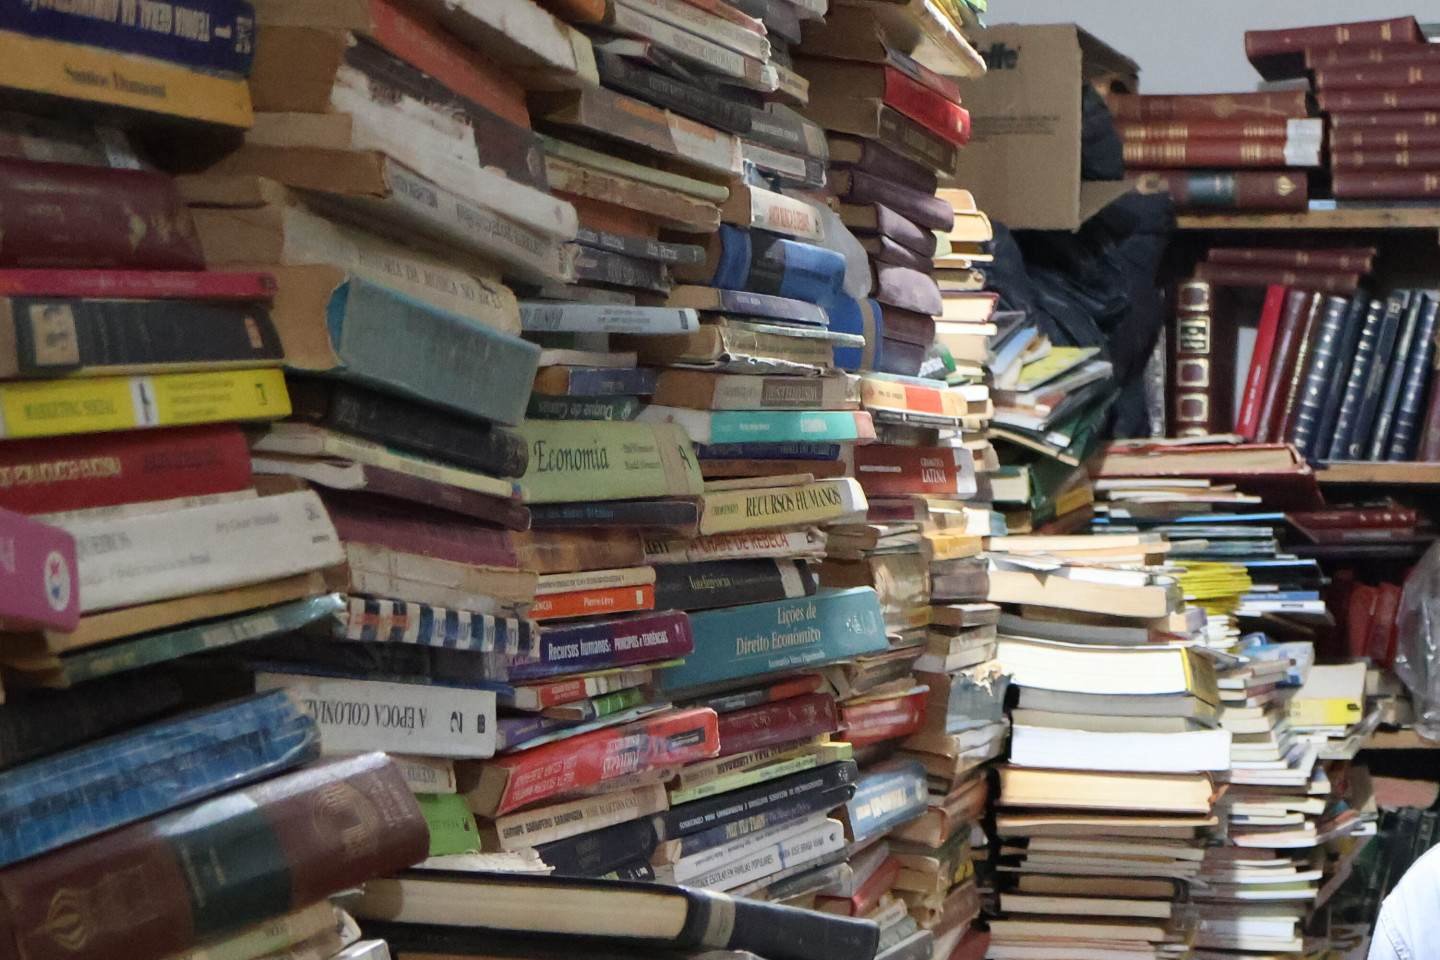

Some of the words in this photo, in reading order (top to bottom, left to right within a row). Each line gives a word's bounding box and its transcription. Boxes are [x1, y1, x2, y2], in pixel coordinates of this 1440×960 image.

[585, 400, 613, 420] Duque
[533, 439, 609, 472] Economia
[922, 468, 947, 483] LATINA
[746, 493, 794, 517] RECURSOS
[796, 486, 842, 511] HUMANOS
[736, 534, 750, 550] DE
[752, 532, 789, 550] REBECA
[777, 604, 804, 628] Lições
[805, 602, 817, 620] de
[548, 642, 580, 661] Recursos
[580, 637, 612, 656] humanos:
[736, 634, 769, 656] Direito
[772, 626, 821, 650] Econômico
[304, 700, 371, 726] COLONIAL
[375, 705, 417, 737] ÉPOCA
[418, 708, 427, 727] A
[679, 815, 704, 830] CONCURSOS
[751, 854, 774, 874] POPULARES
